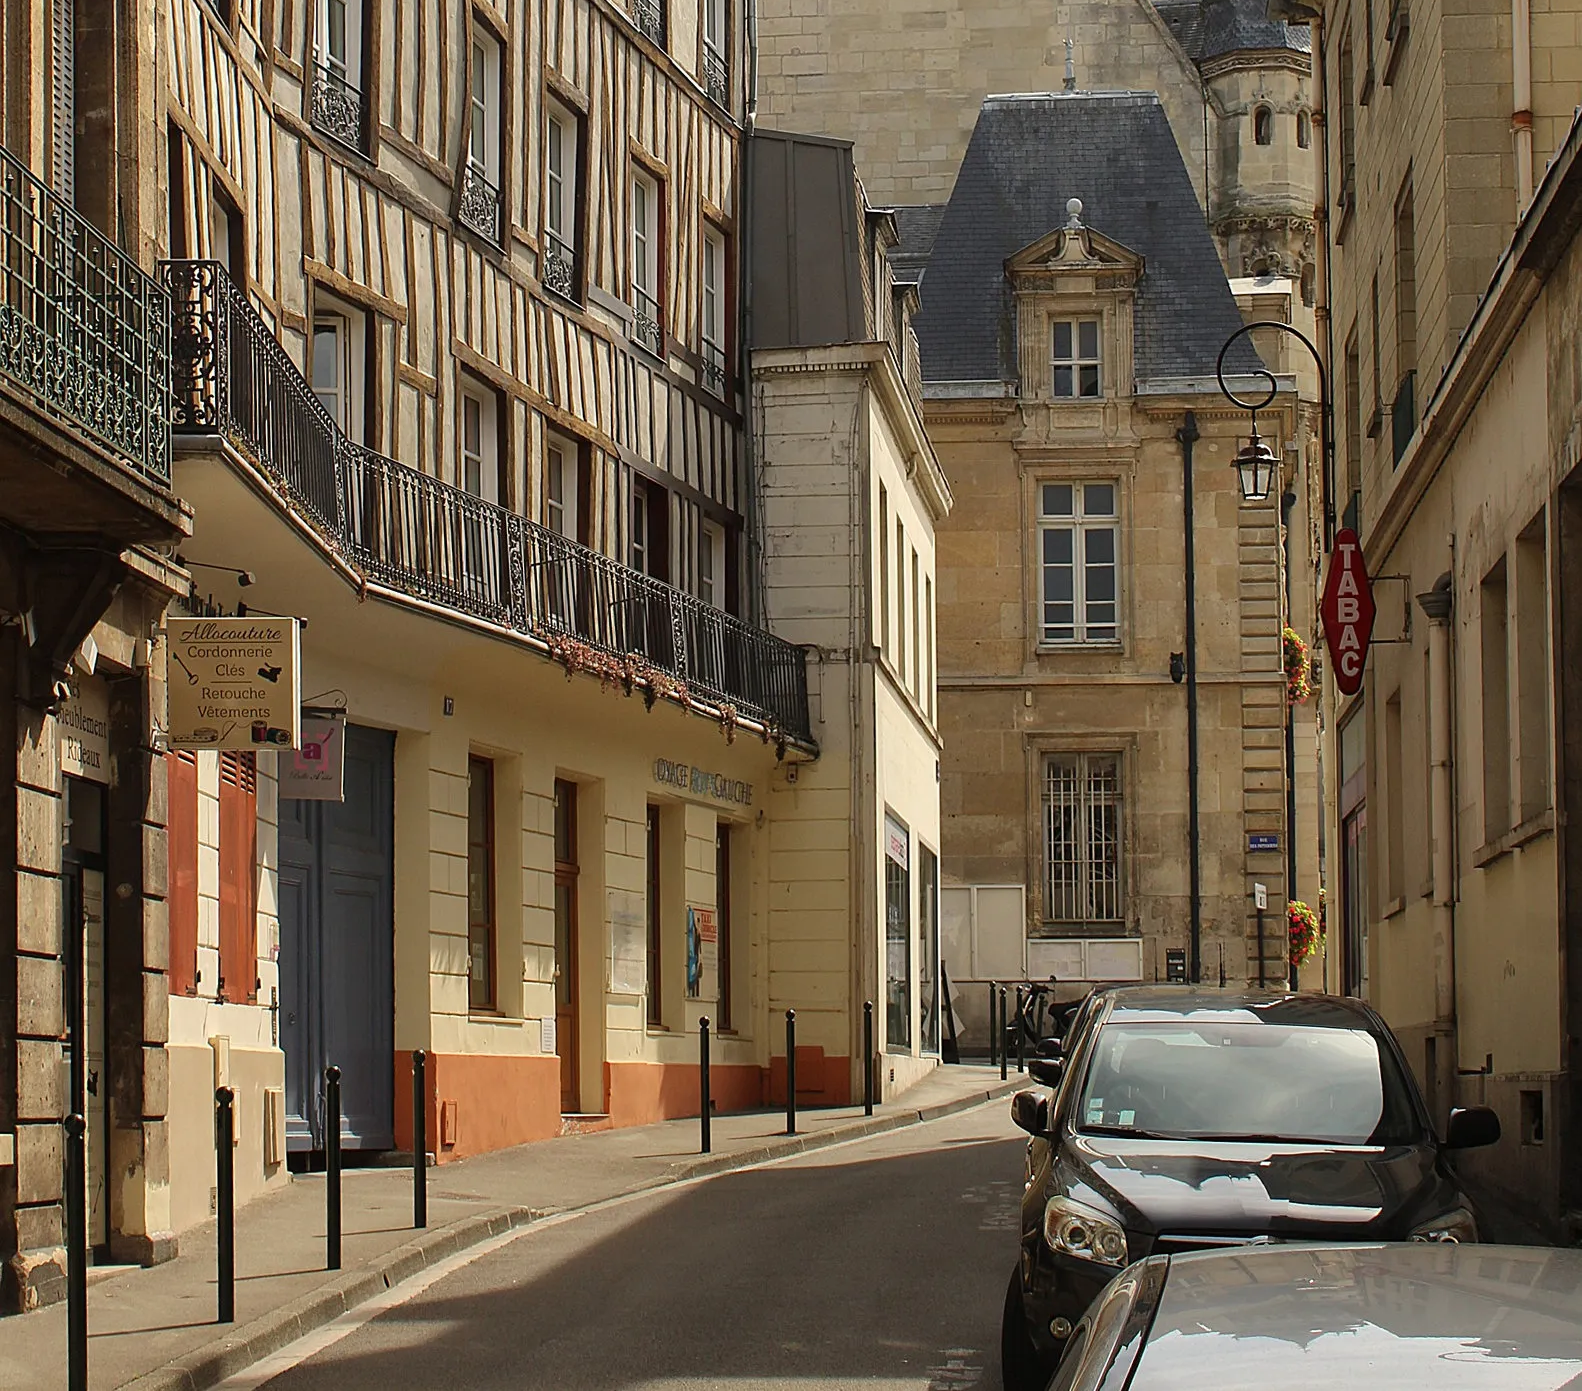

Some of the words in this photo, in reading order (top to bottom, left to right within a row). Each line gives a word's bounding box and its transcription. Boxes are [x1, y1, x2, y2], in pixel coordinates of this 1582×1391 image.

[1337, 543, 1360, 677] TABAC
[180, 622, 282, 642] Allocouture
[187, 645, 273, 659] Cordonnerie
[215, 663, 245, 677] Clés
[201, 687, 266, 700] Retouche
[197, 705, 271, 718] Vêtements
[67, 736, 101, 769] Rideaux
